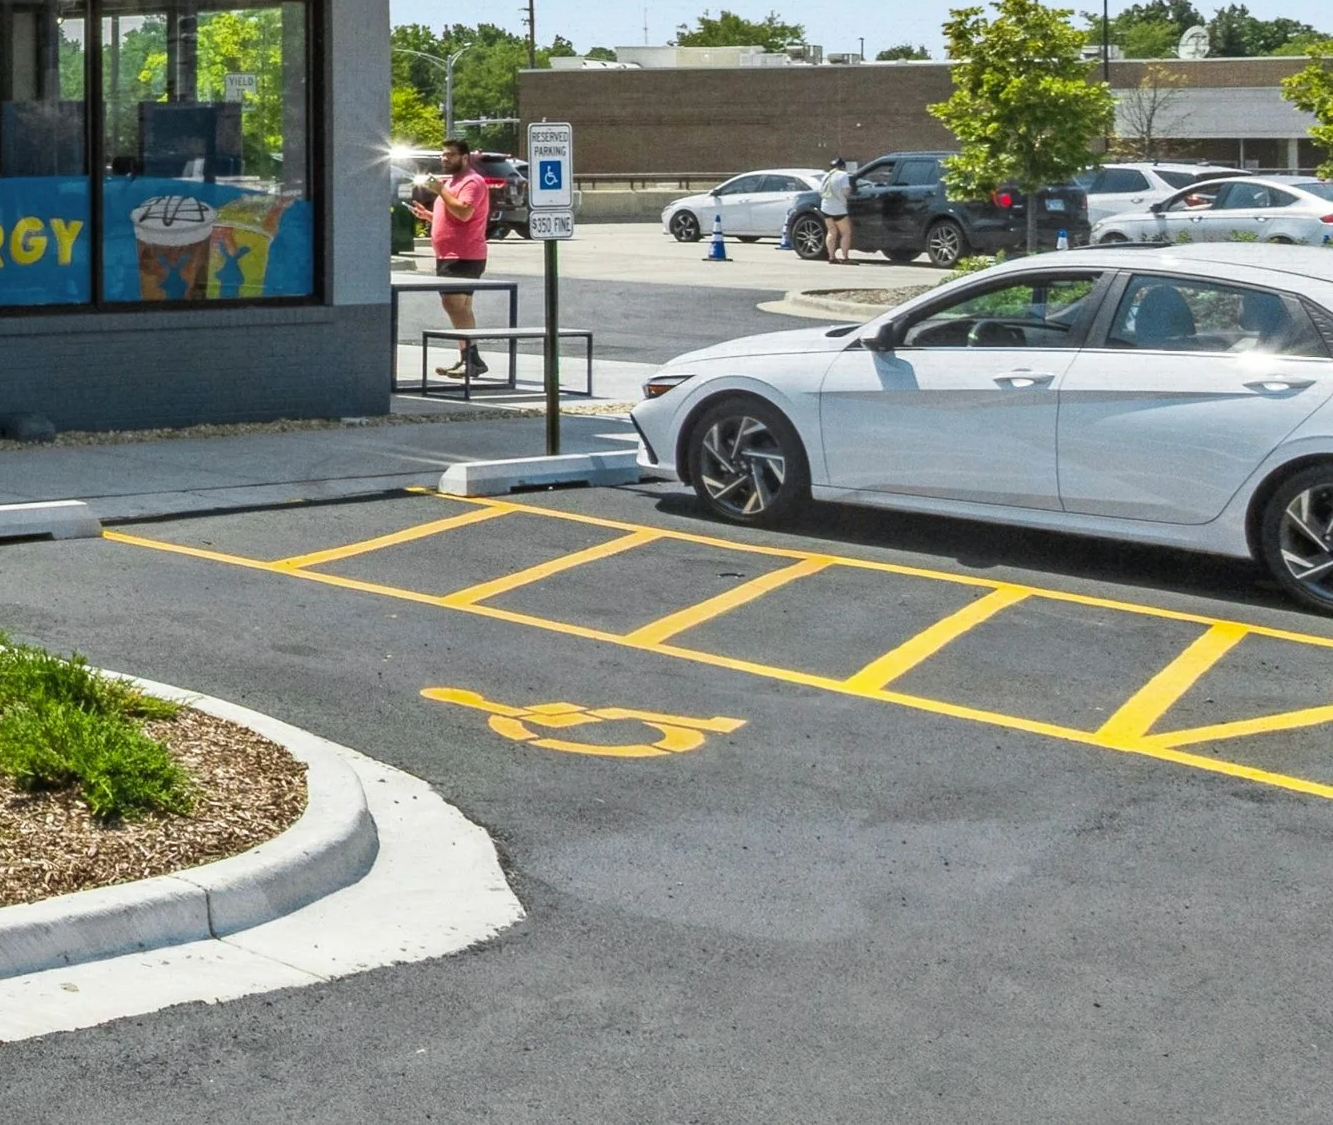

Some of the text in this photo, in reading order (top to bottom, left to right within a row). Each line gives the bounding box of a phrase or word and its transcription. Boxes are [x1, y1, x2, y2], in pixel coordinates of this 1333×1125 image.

[228, 76, 254, 86] YIELD
[532, 131, 569, 143] RESERVED
[534, 146, 567, 157] PARKING
[532, 217, 571, 233] $350 FINE
